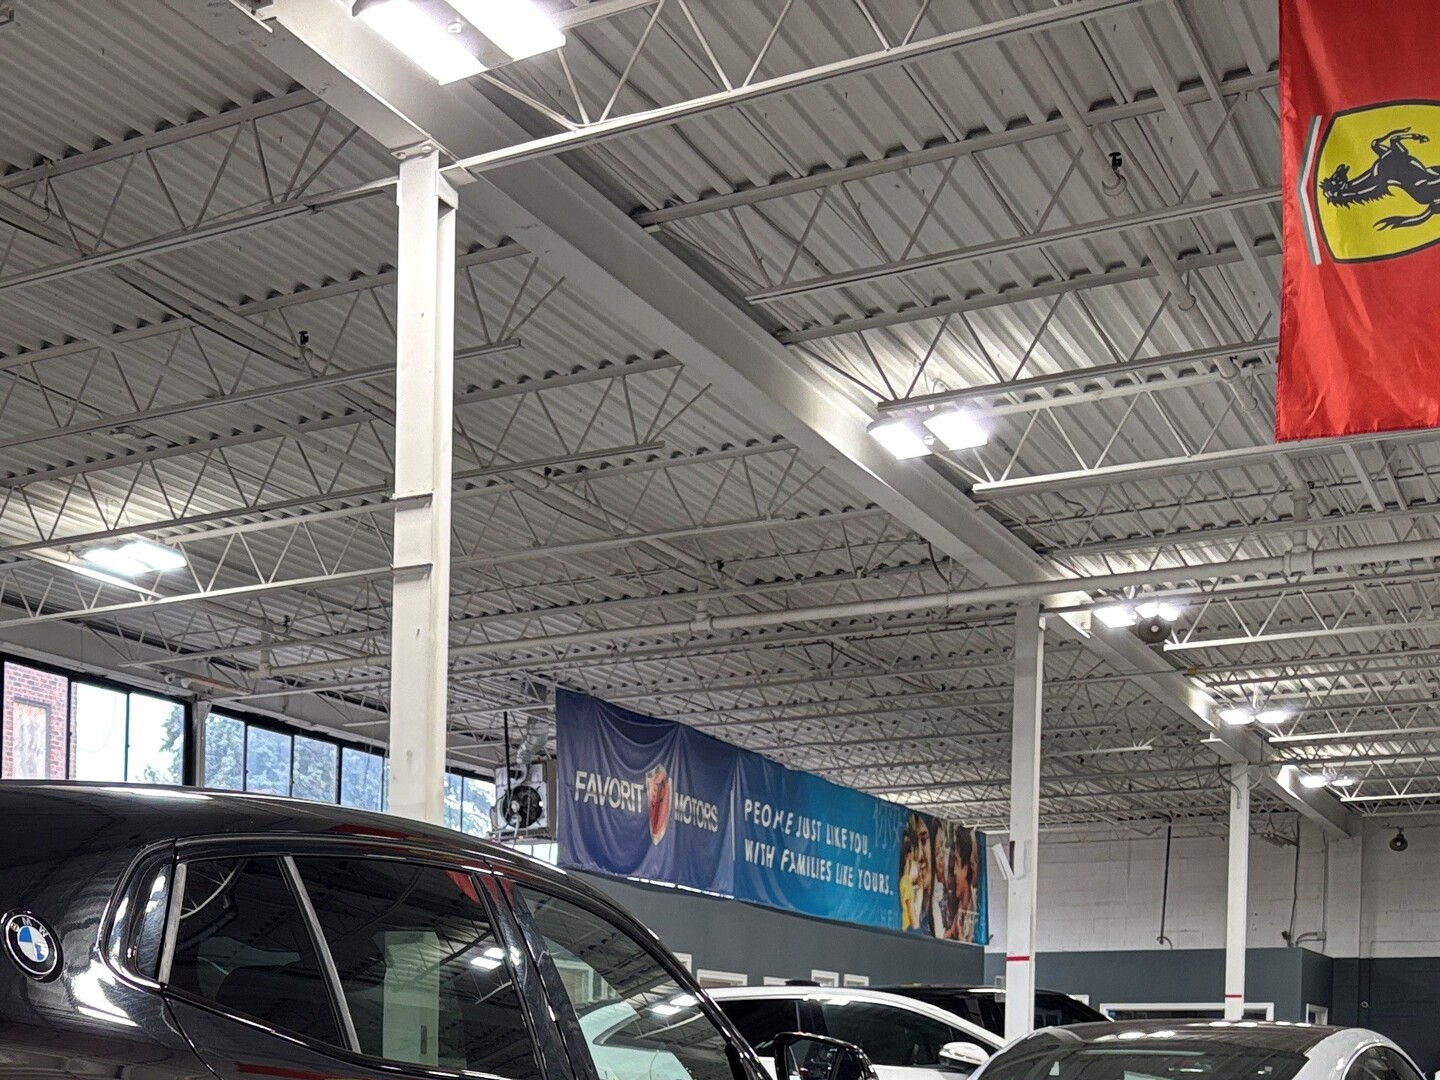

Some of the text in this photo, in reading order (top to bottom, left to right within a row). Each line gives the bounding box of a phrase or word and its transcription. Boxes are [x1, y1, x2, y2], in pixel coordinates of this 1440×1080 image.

[575, 770, 644, 813] FAVORIT
[675, 792, 719, 832] MOTORS
[796, 816, 822, 842] JUST
[826, 824, 848, 849] LIKE
[744, 839, 776, 869] WITH
[835, 863, 854, 887] LIKE
[858, 869, 894, 896] YOURS.
